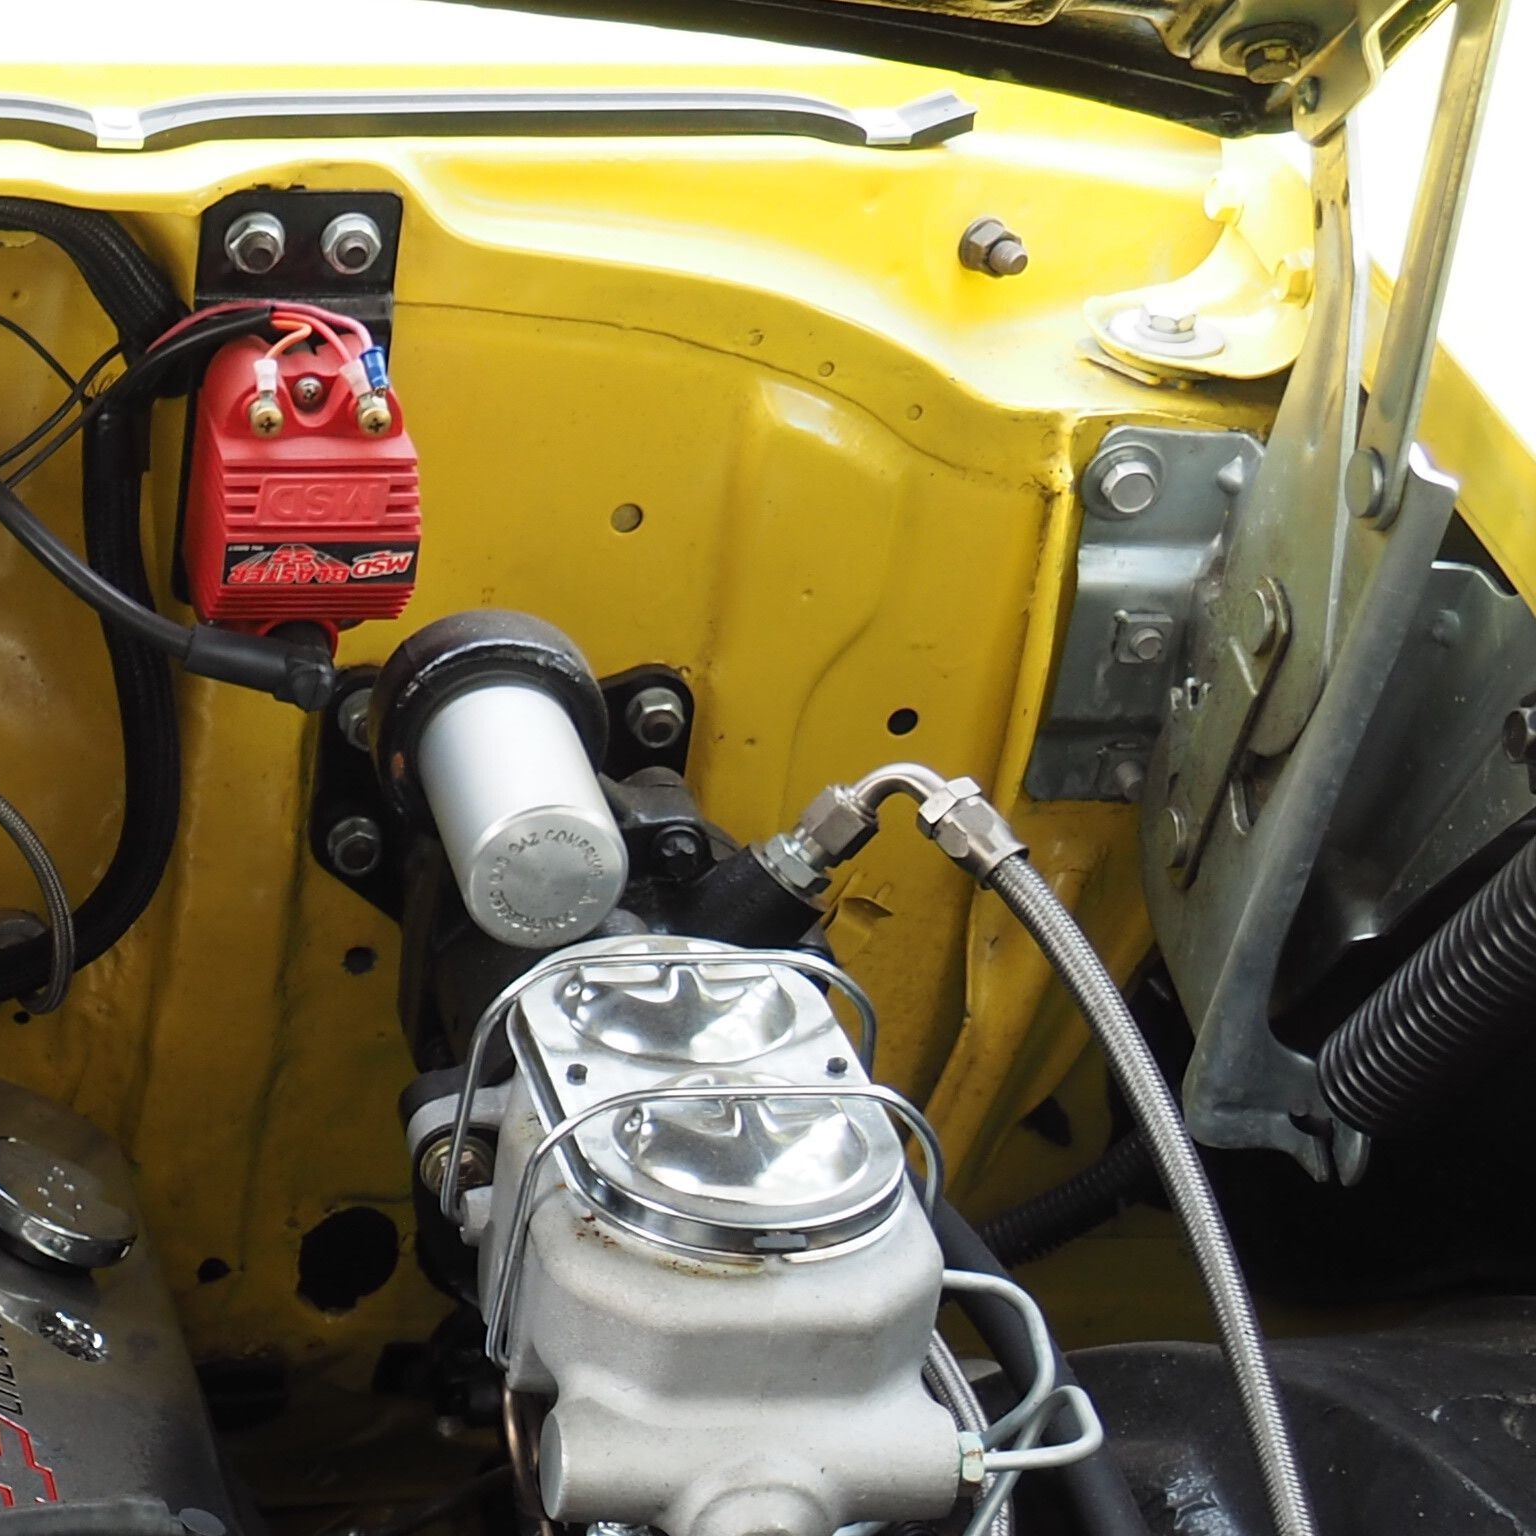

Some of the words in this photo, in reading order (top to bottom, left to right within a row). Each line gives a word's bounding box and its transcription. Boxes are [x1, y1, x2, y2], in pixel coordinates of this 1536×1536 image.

[270, 484, 379, 522] MSD
[228, 563, 350, 584] BLASTER
[351, 551, 414, 579] MSD
